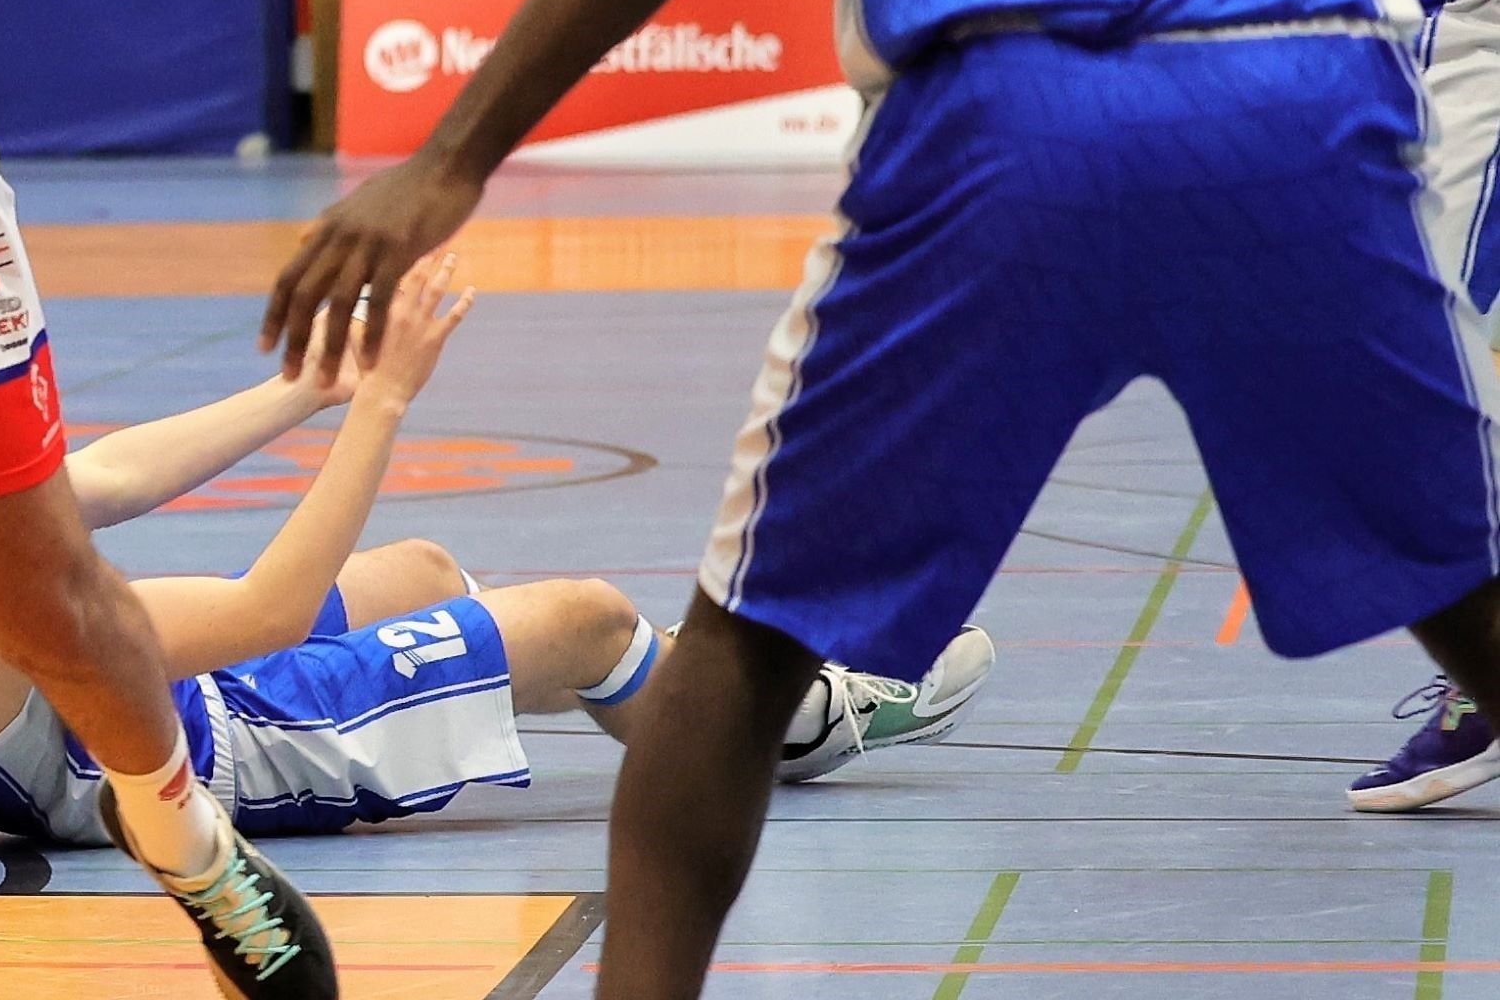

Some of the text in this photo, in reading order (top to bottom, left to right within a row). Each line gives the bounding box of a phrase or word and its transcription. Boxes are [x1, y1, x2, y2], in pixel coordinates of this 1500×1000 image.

[442, 22, 783, 75] Ne stfälische
[377, 609, 467, 680] 12
